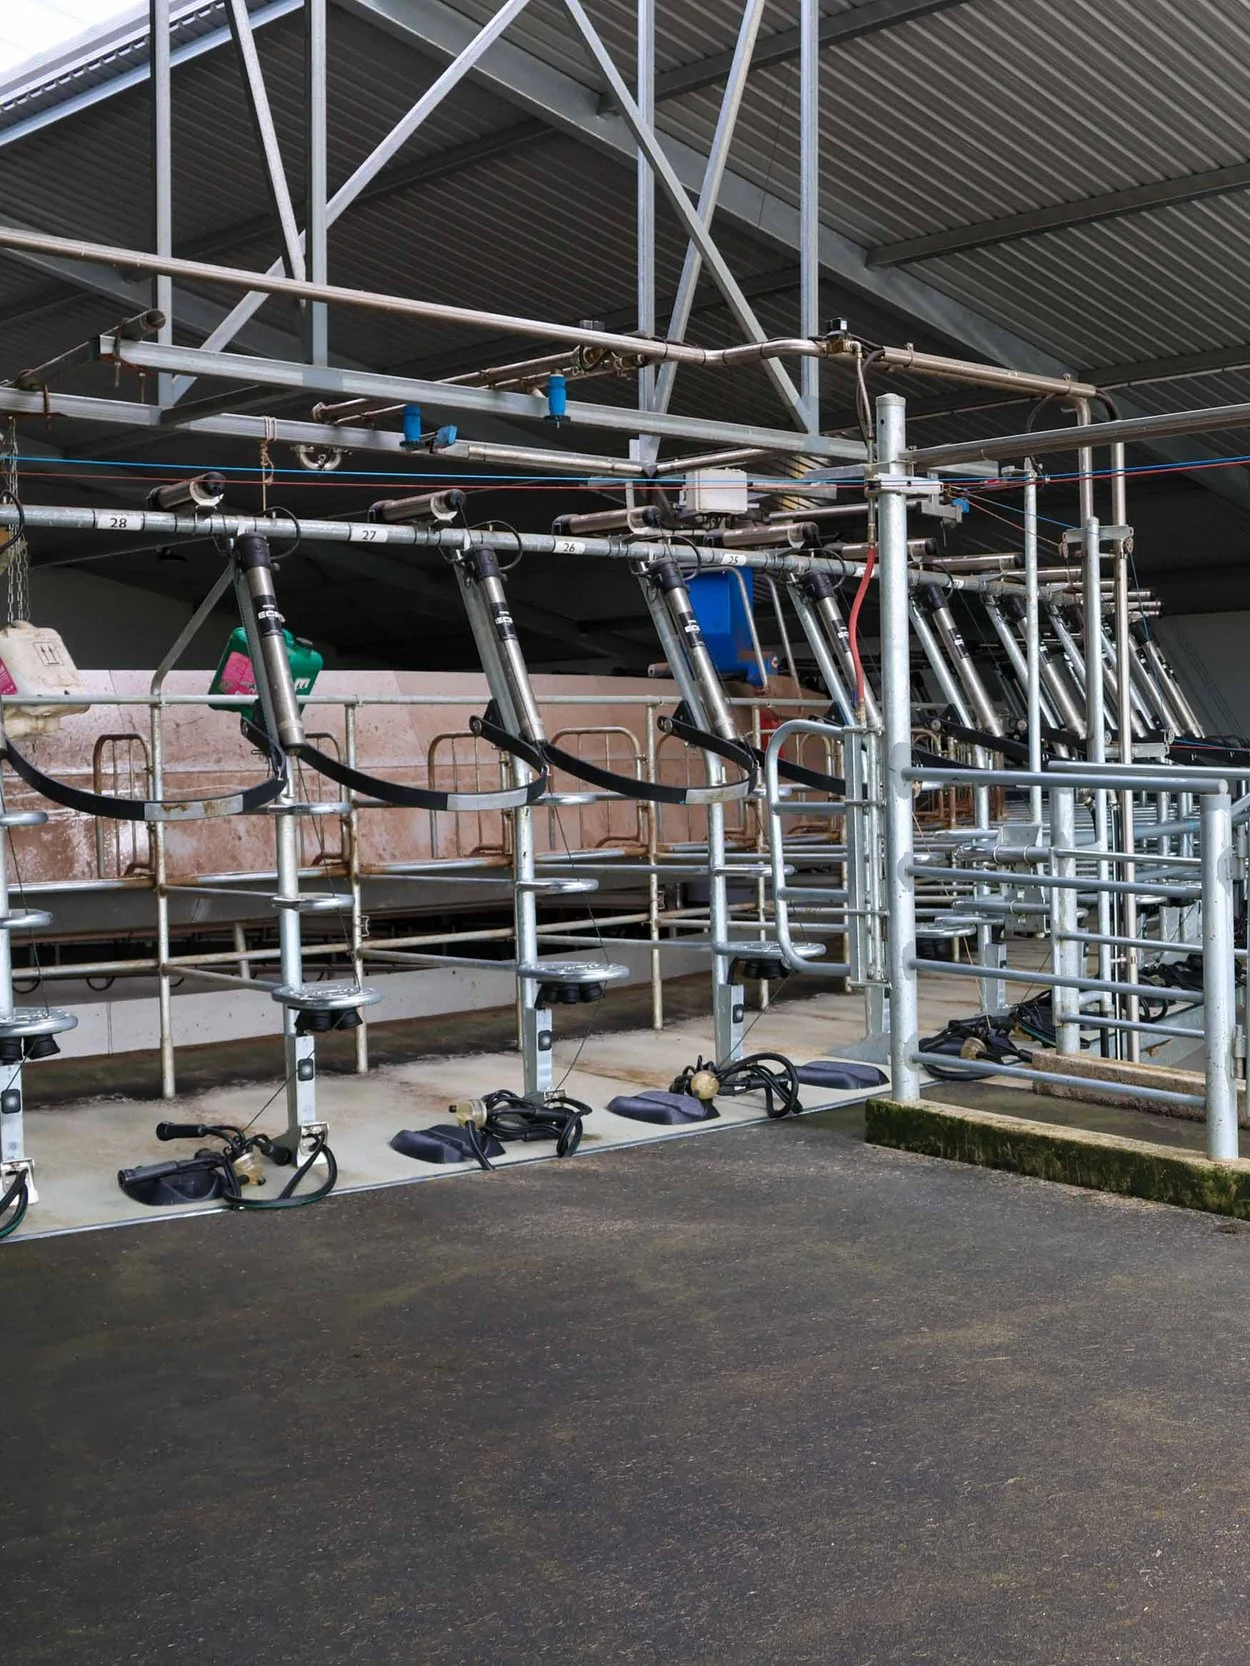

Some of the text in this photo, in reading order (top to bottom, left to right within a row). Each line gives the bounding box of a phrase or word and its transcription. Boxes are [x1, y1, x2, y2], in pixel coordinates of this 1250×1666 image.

[109, 517, 128, 528] 28
[362, 529, 377, 541] 27
[563, 541, 576, 553] 26
[728, 555, 739, 565] 25
